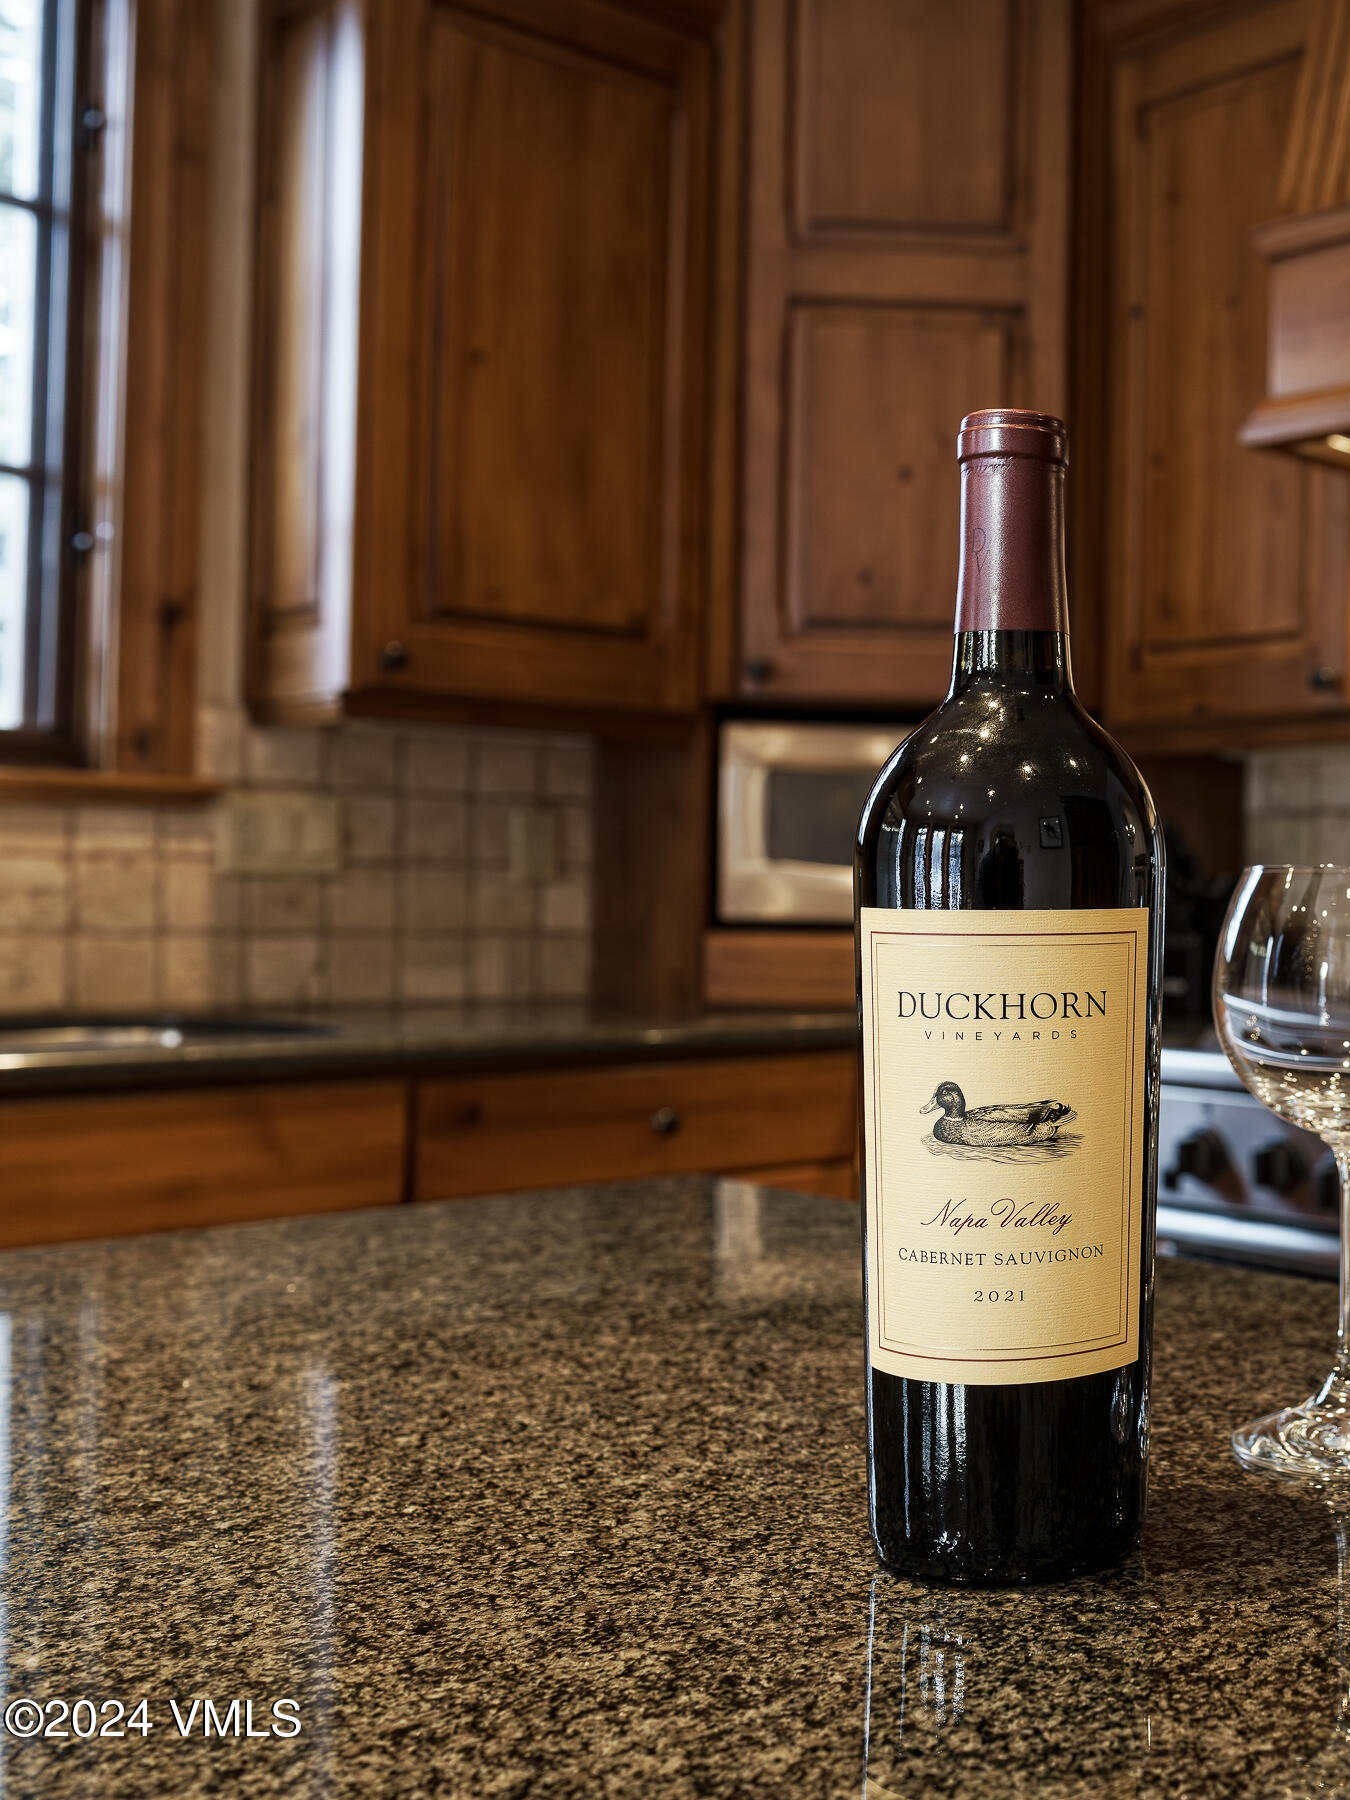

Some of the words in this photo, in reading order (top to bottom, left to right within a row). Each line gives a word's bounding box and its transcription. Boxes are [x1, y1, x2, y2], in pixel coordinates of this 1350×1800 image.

[896, 990, 1108, 1021] DUCKHORN
[924, 1029, 1078, 1041] VINEYARDS
[920, 1198, 989, 1236] Napa
[990, 1197, 1073, 1236] Valley
[898, 1247, 987, 1267] CABERNET
[993, 1243, 1105, 1267] SAUVIGNON
[972, 1289, 1026, 1303] 2021
